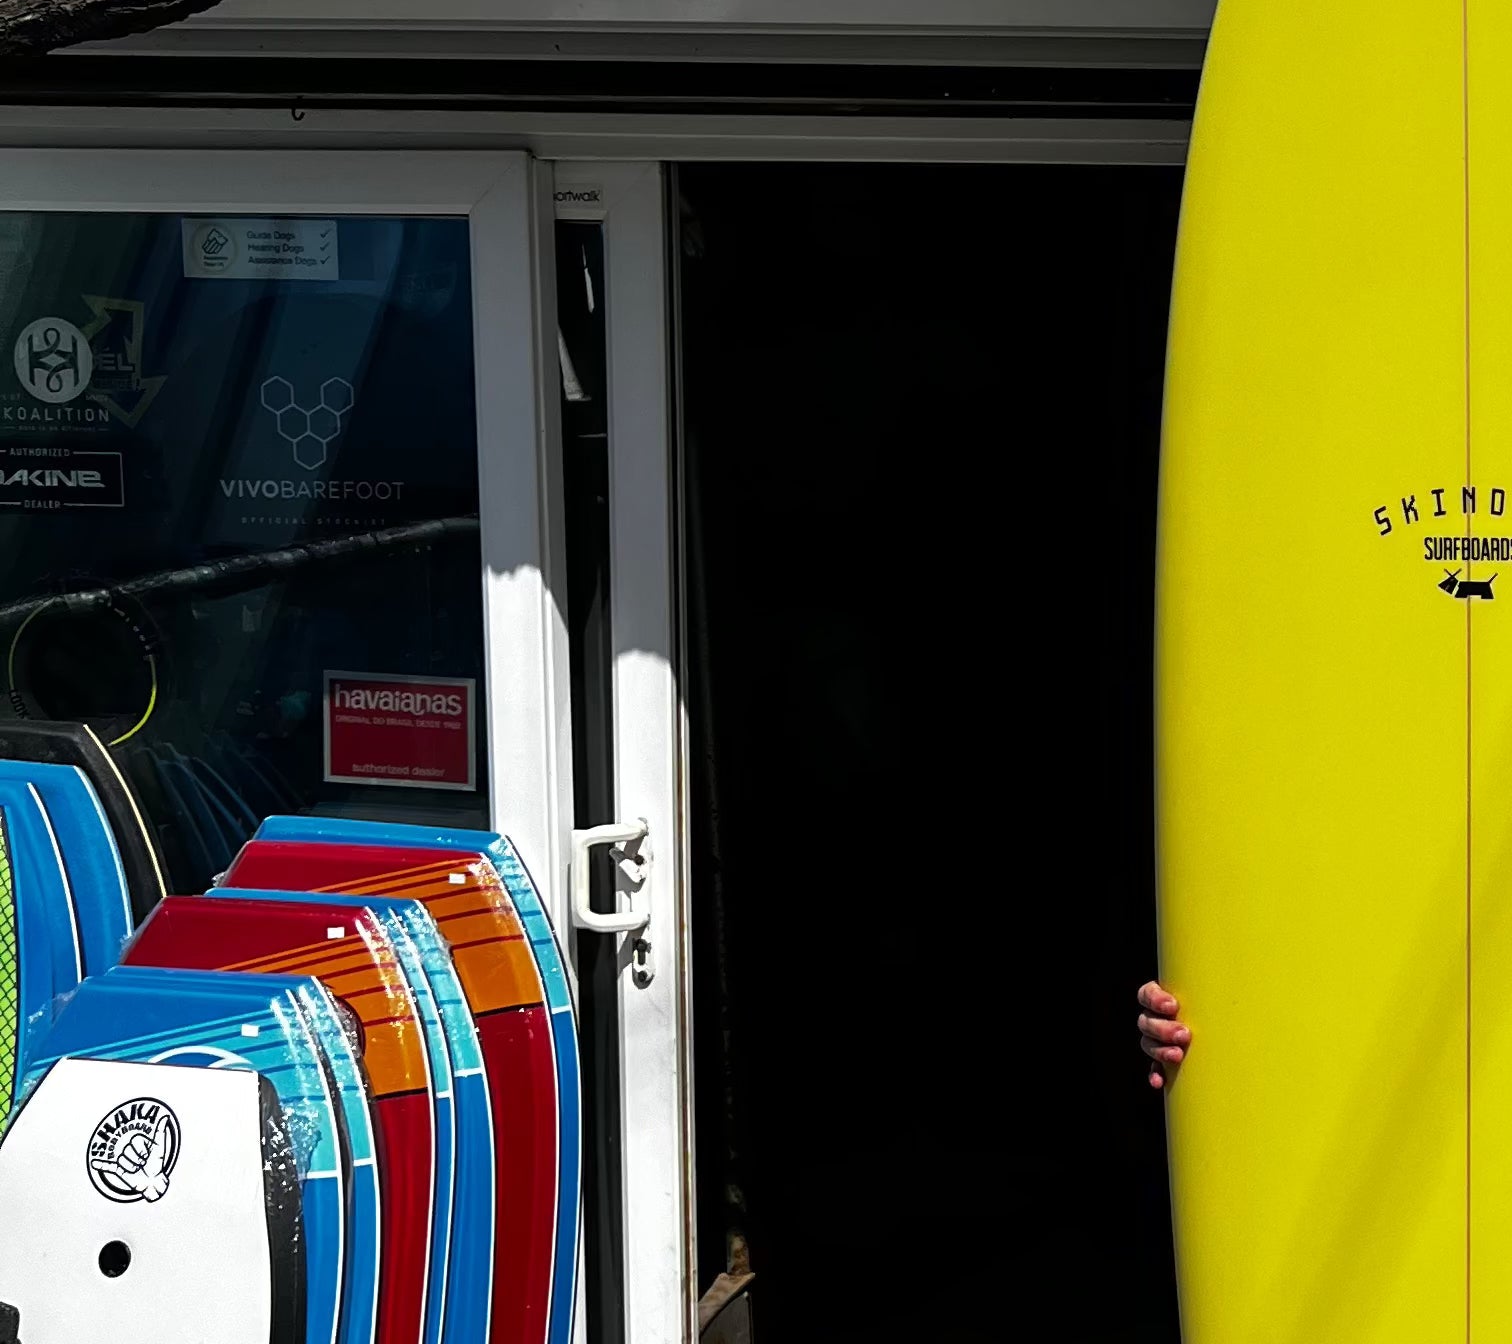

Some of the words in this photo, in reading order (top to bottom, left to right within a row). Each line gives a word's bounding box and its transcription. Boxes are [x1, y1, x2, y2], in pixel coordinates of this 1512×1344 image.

[2, 406, 111, 423] KOALITION
[9, 447, 71, 457] AUTHORIZED
[219, 478, 405, 501] VIVOBAREFOOT
[24, 499, 62, 509] DEALER
[333, 682, 463, 717] havaianas
[91, 1103, 160, 1157] SHAKA
